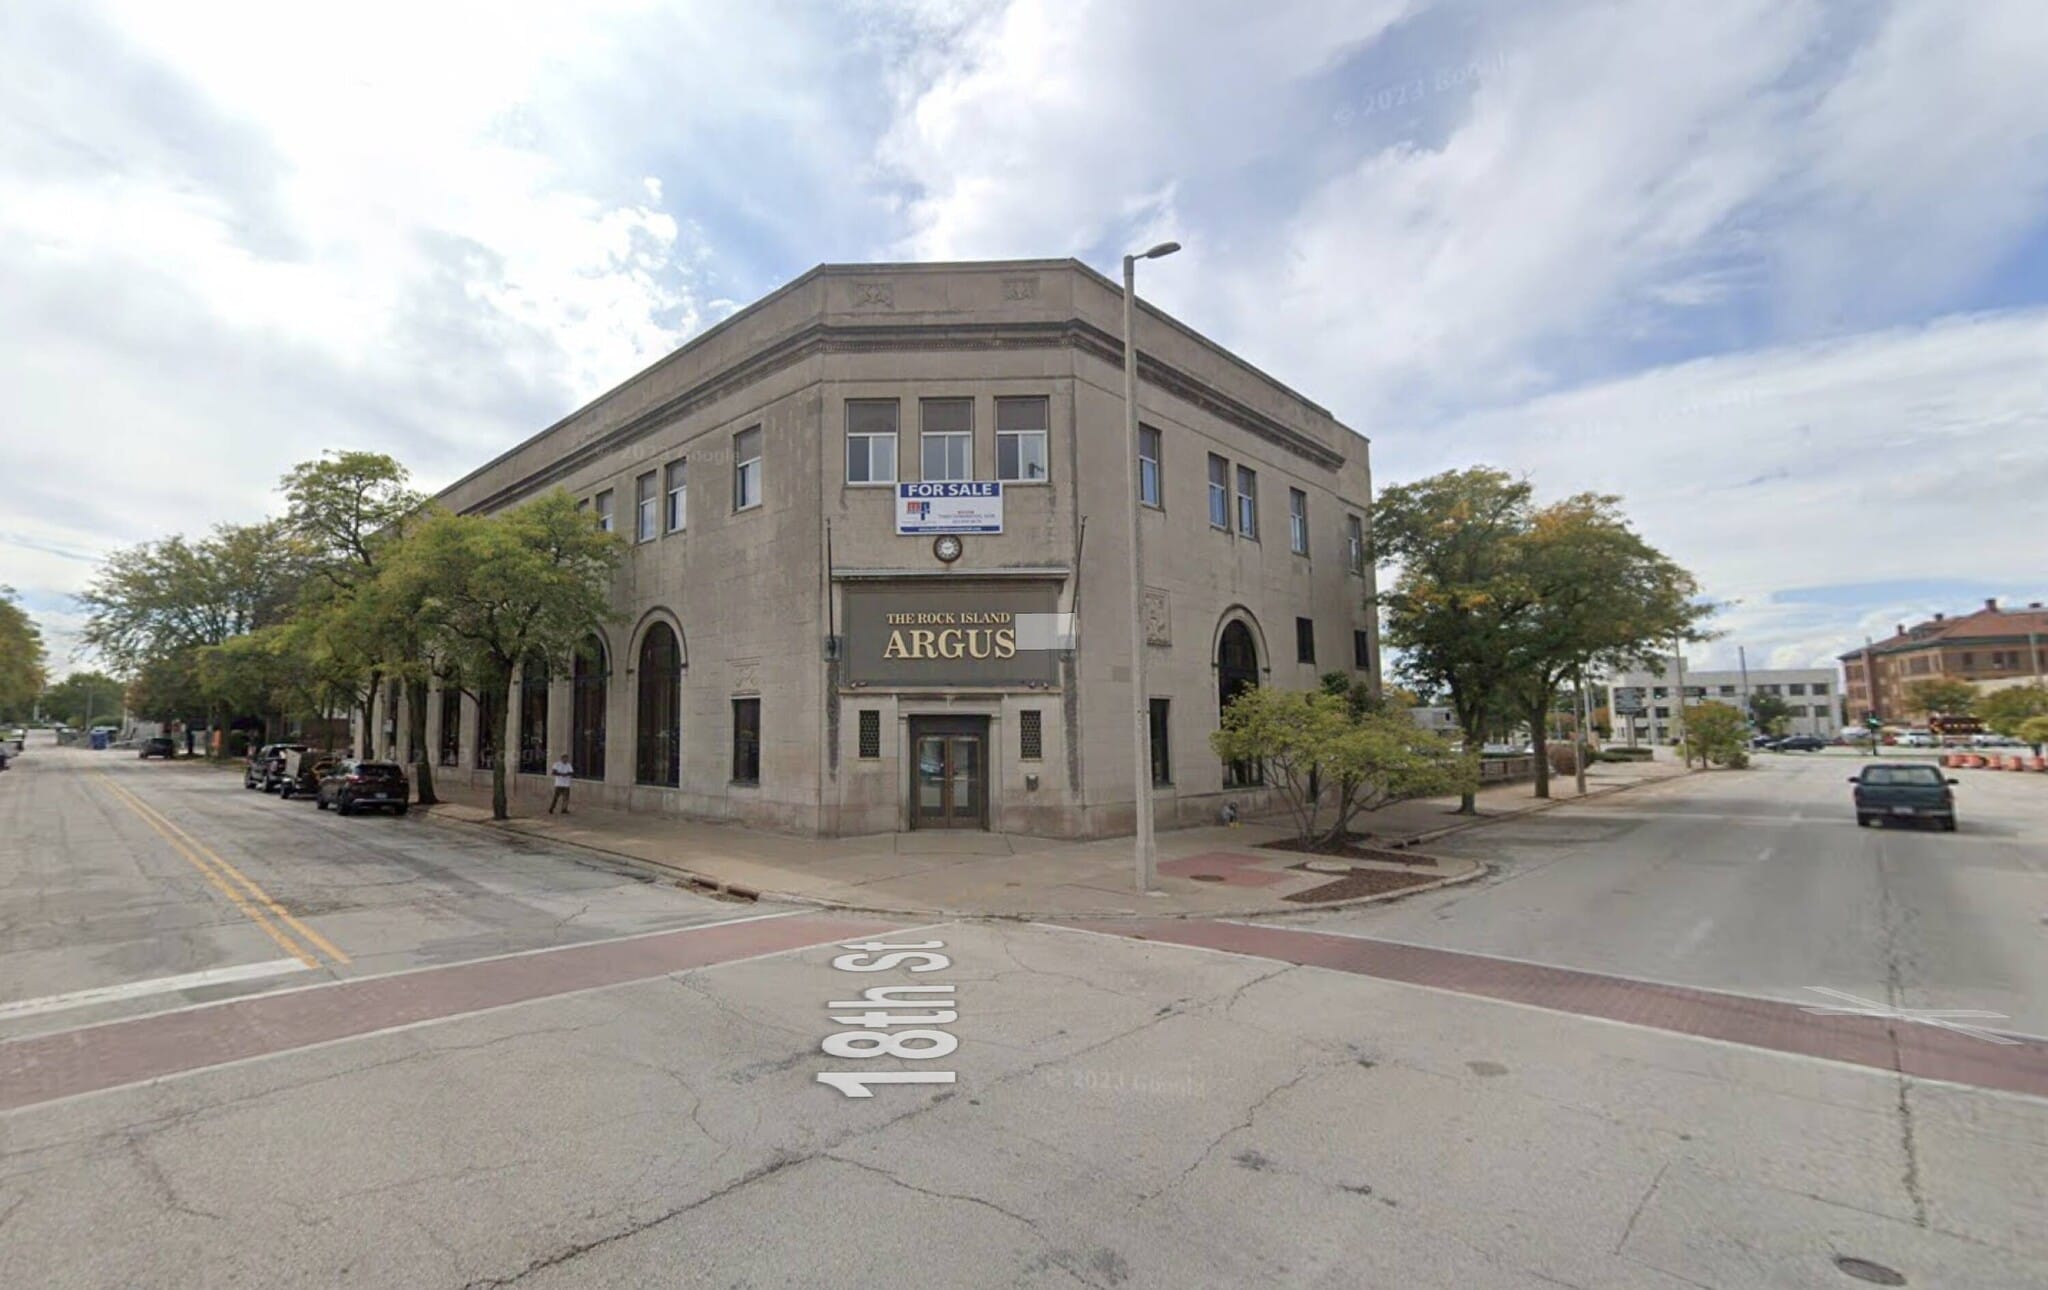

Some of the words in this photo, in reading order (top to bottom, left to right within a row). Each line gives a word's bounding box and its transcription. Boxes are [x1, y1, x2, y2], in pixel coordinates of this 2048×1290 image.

[908, 484, 944, 496] FOR
[948, 483, 993, 496] SALE
[886, 613, 915, 625] THE
[918, 613, 955, 624] ROCK
[961, 612, 1010, 624] ISLAND
[883, 628, 1016, 659] ARGUS
